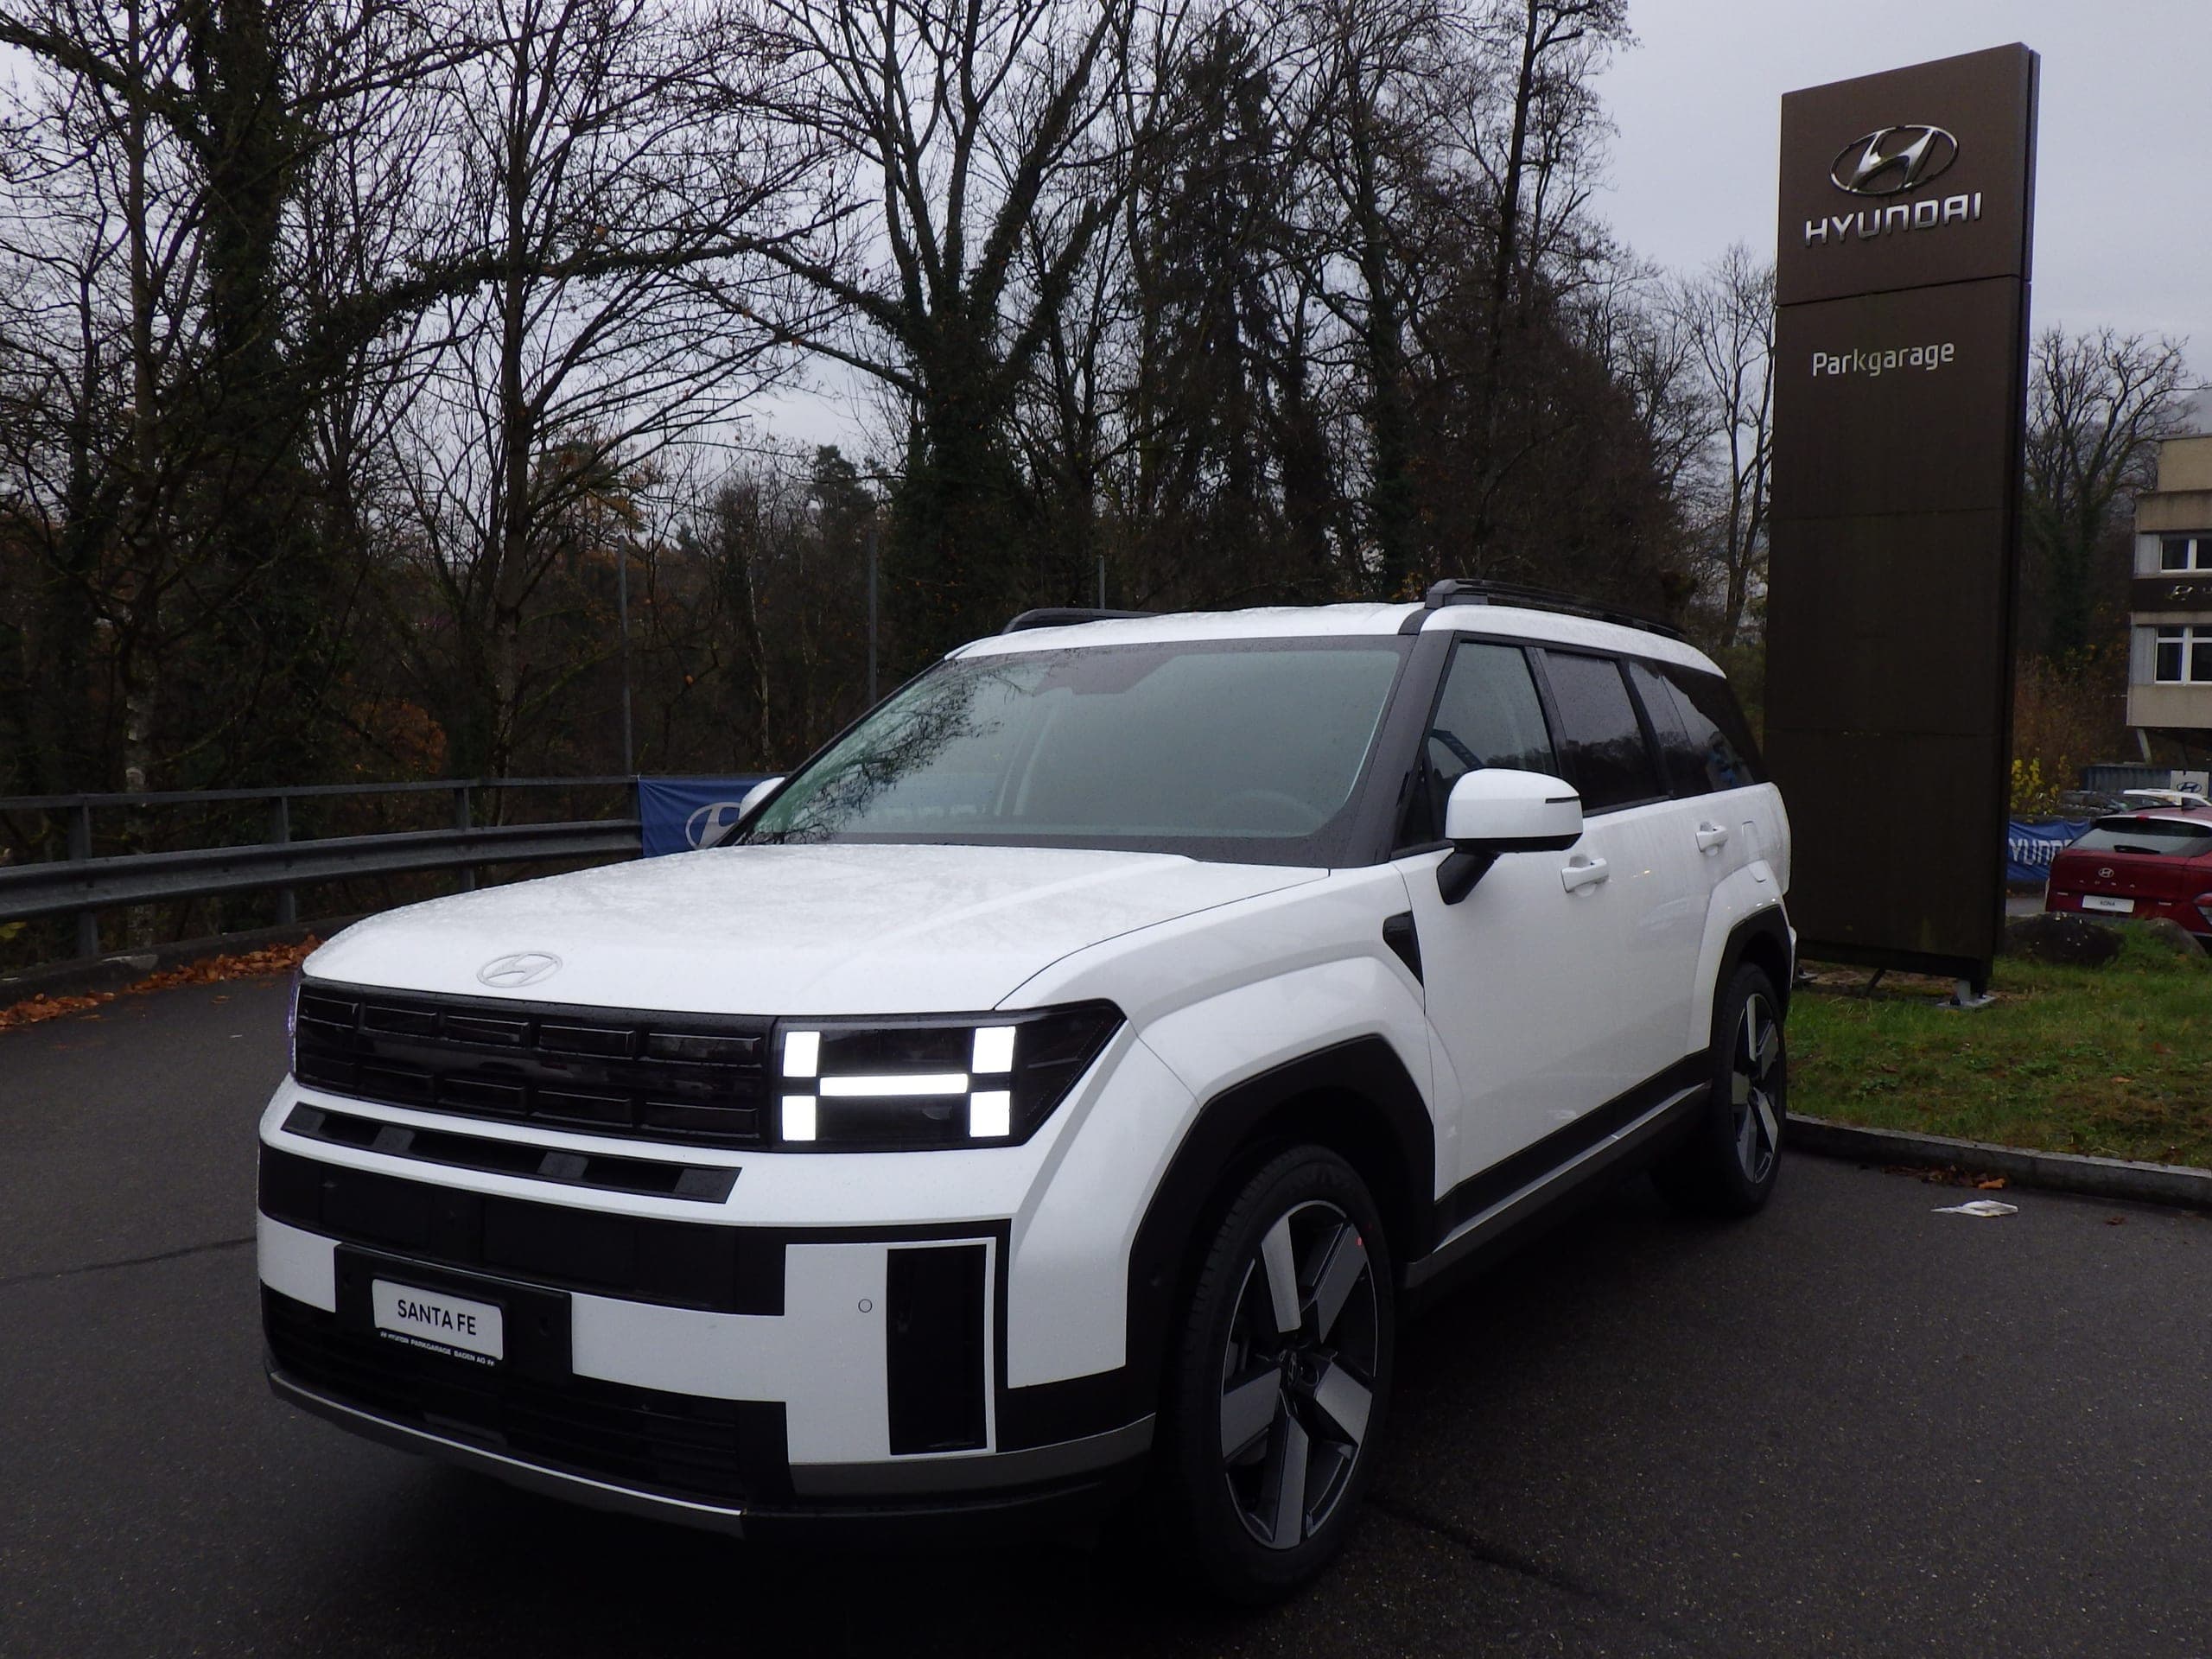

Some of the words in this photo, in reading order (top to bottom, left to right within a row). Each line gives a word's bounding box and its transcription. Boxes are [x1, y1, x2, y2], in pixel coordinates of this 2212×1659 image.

[1805, 192, 1983, 248] HYUNDAI
[1812, 342, 1955, 377] Parkgarage
[2008, 837, 2073, 865] YUND
[397, 1299, 454, 1331] SANTA
[457, 1313, 477, 1336] FE
